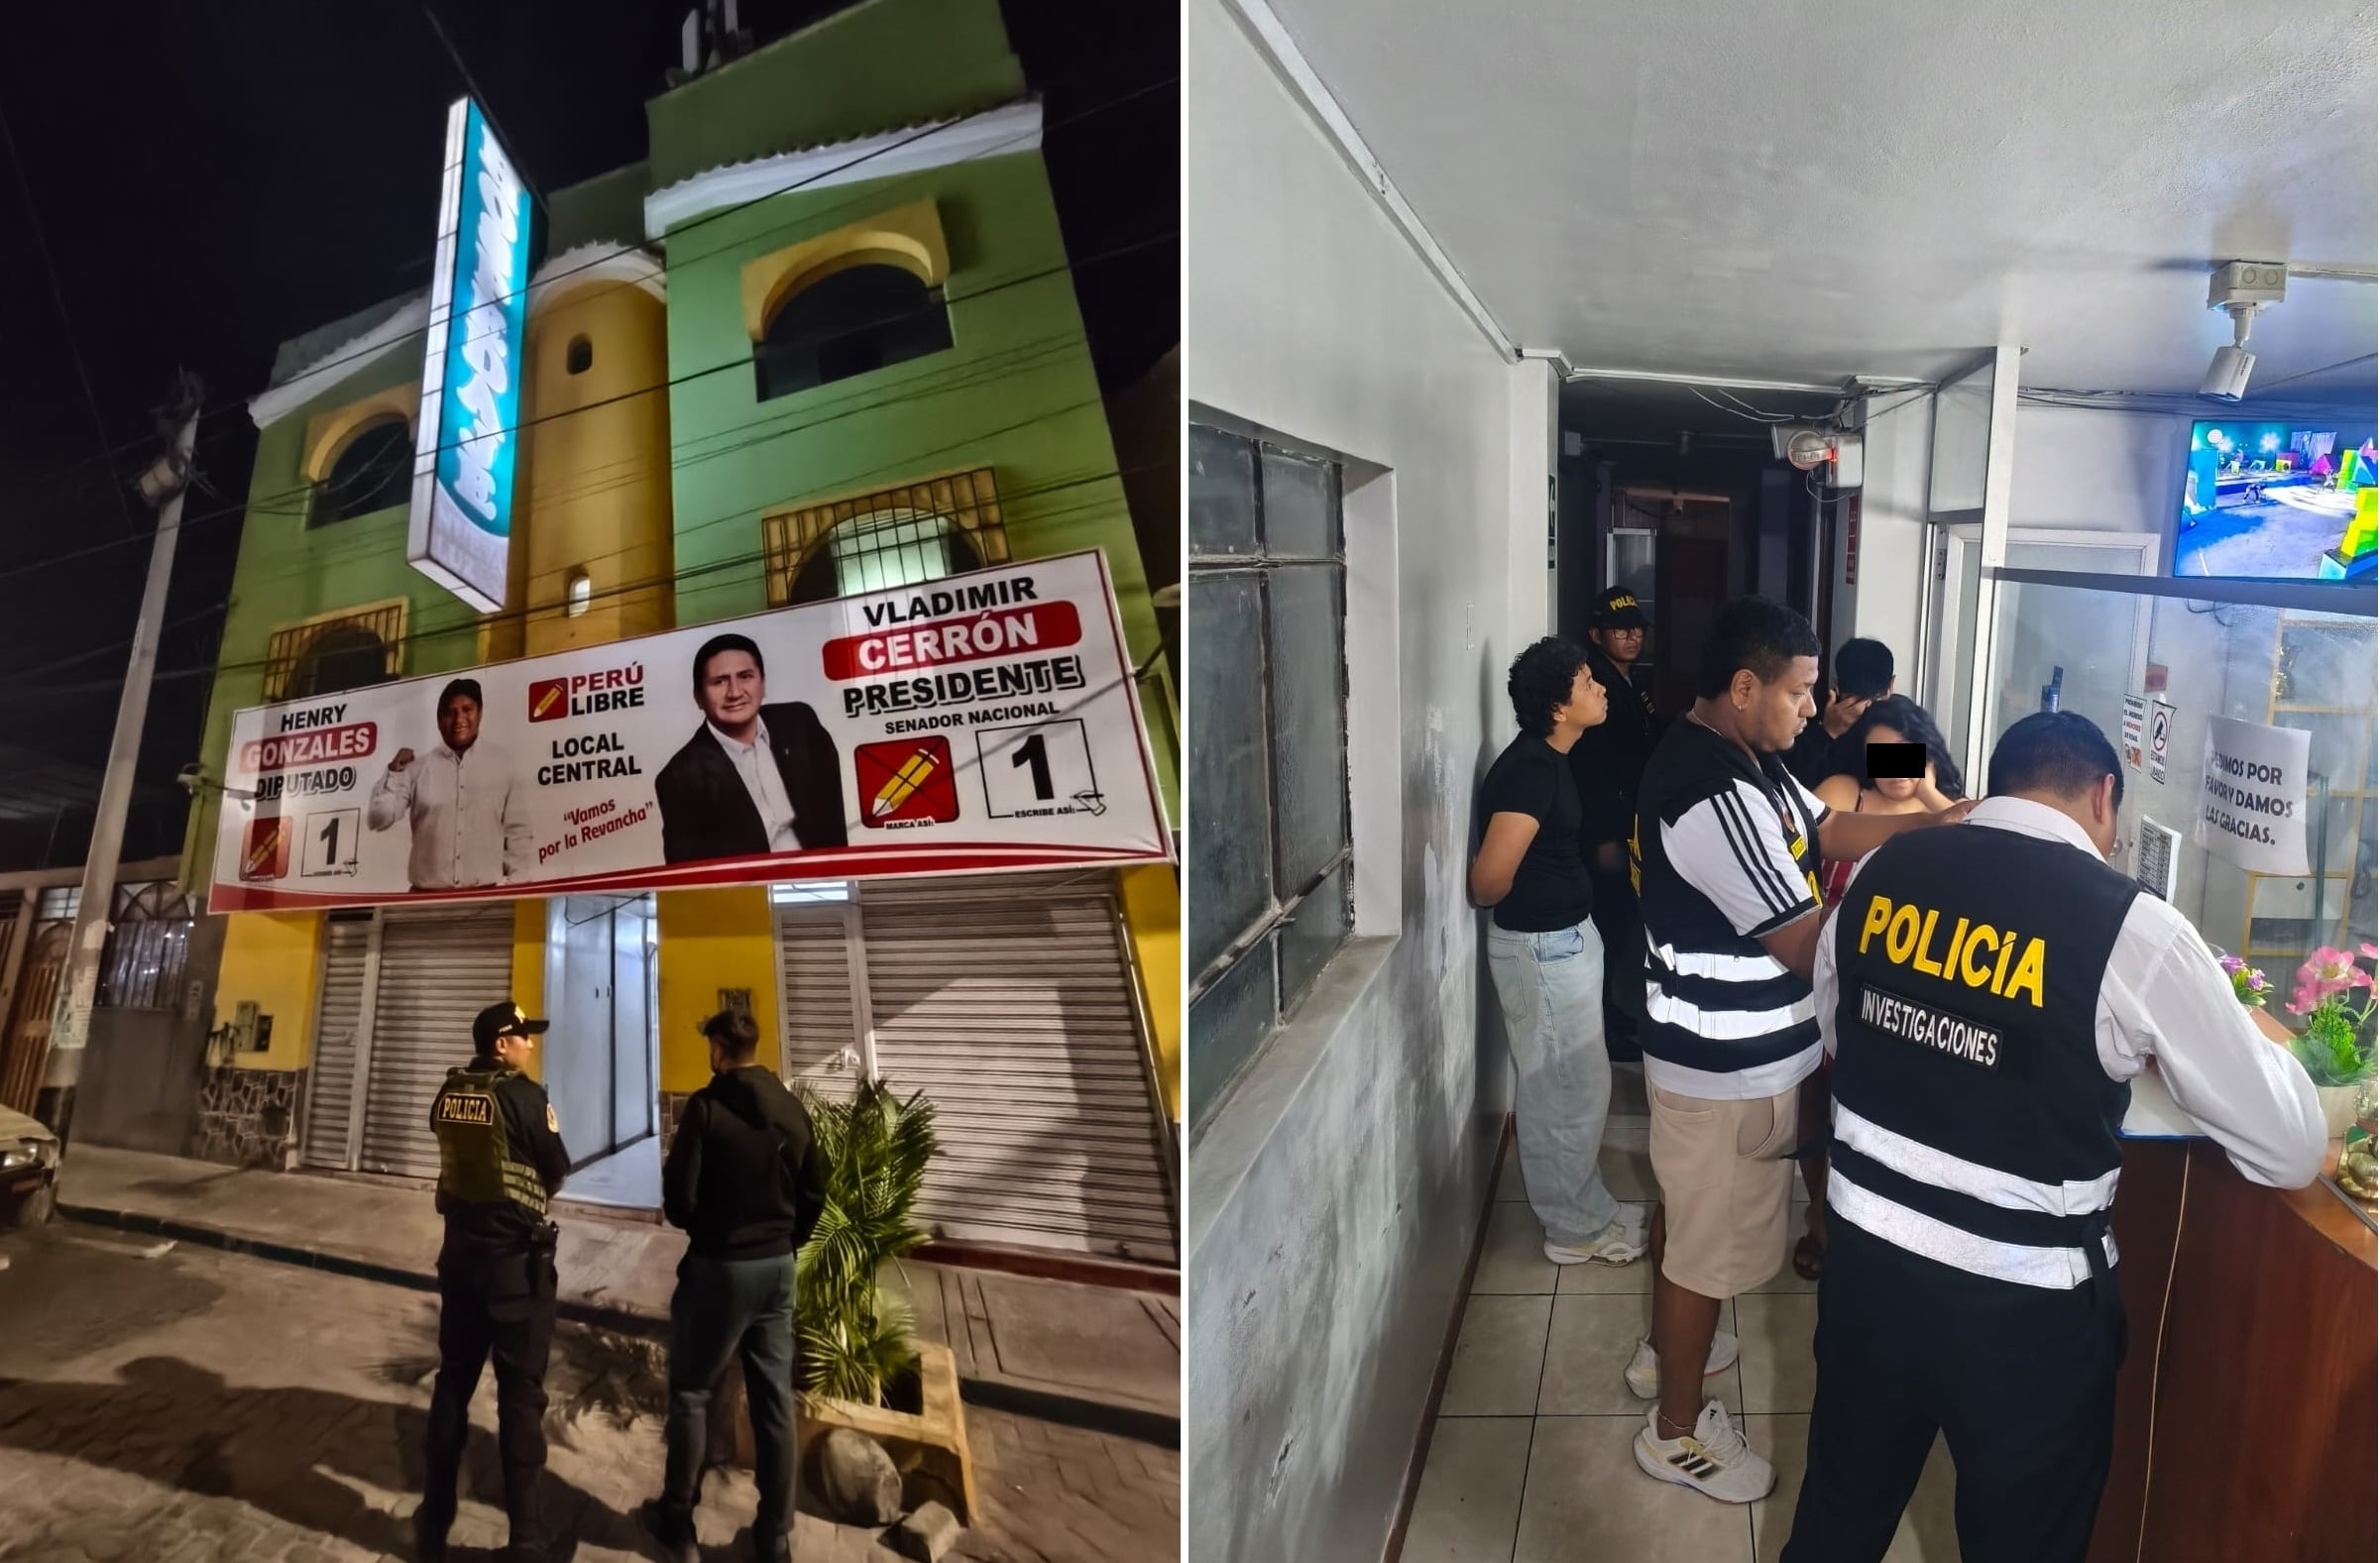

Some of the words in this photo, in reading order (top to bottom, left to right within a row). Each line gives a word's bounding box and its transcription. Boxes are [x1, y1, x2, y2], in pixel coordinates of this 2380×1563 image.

[863, 576, 1038, 626] VLADIMIR
[857, 613, 1038, 671] CERRÓN
[571, 661, 643, 694] PERÚ
[844, 654, 1086, 719] PRESIDENTE
[281, 703, 347, 732] HENRY
[571, 687, 644, 716] LIBRE
[885, 714, 963, 734] SENADOR
[968, 702, 1060, 725] NACIONAL
[249, 726, 371, 768] GONZALES
[552, 732, 624, 759] LOCAL
[255, 766, 357, 802] DIPUTADO
[537, 755, 642, 786] CENTRAL
[1012, 733, 1055, 801] 1
[2246, 762, 2283, 785] POR
[1014, 808, 1054, 818] ESCRIBE
[2206, 775, 2227, 801] FAVOR
[2228, 786, 2234, 804] Y
[2235, 789, 2294, 819] DAMOS
[320, 817, 339, 865] 1
[886, 821, 915, 830] MARCA
[2206, 804, 2219, 825] LAS
[2219, 812, 2276, 845] GRACIAS.
[538, 840, 561, 864] por
[564, 834, 577, 848] la
[1859, 895, 2045, 1008] POLICÍA
[1862, 990, 1998, 1066] INVESTIGACIONES
[442, 1097, 487, 1122] POLICIA
